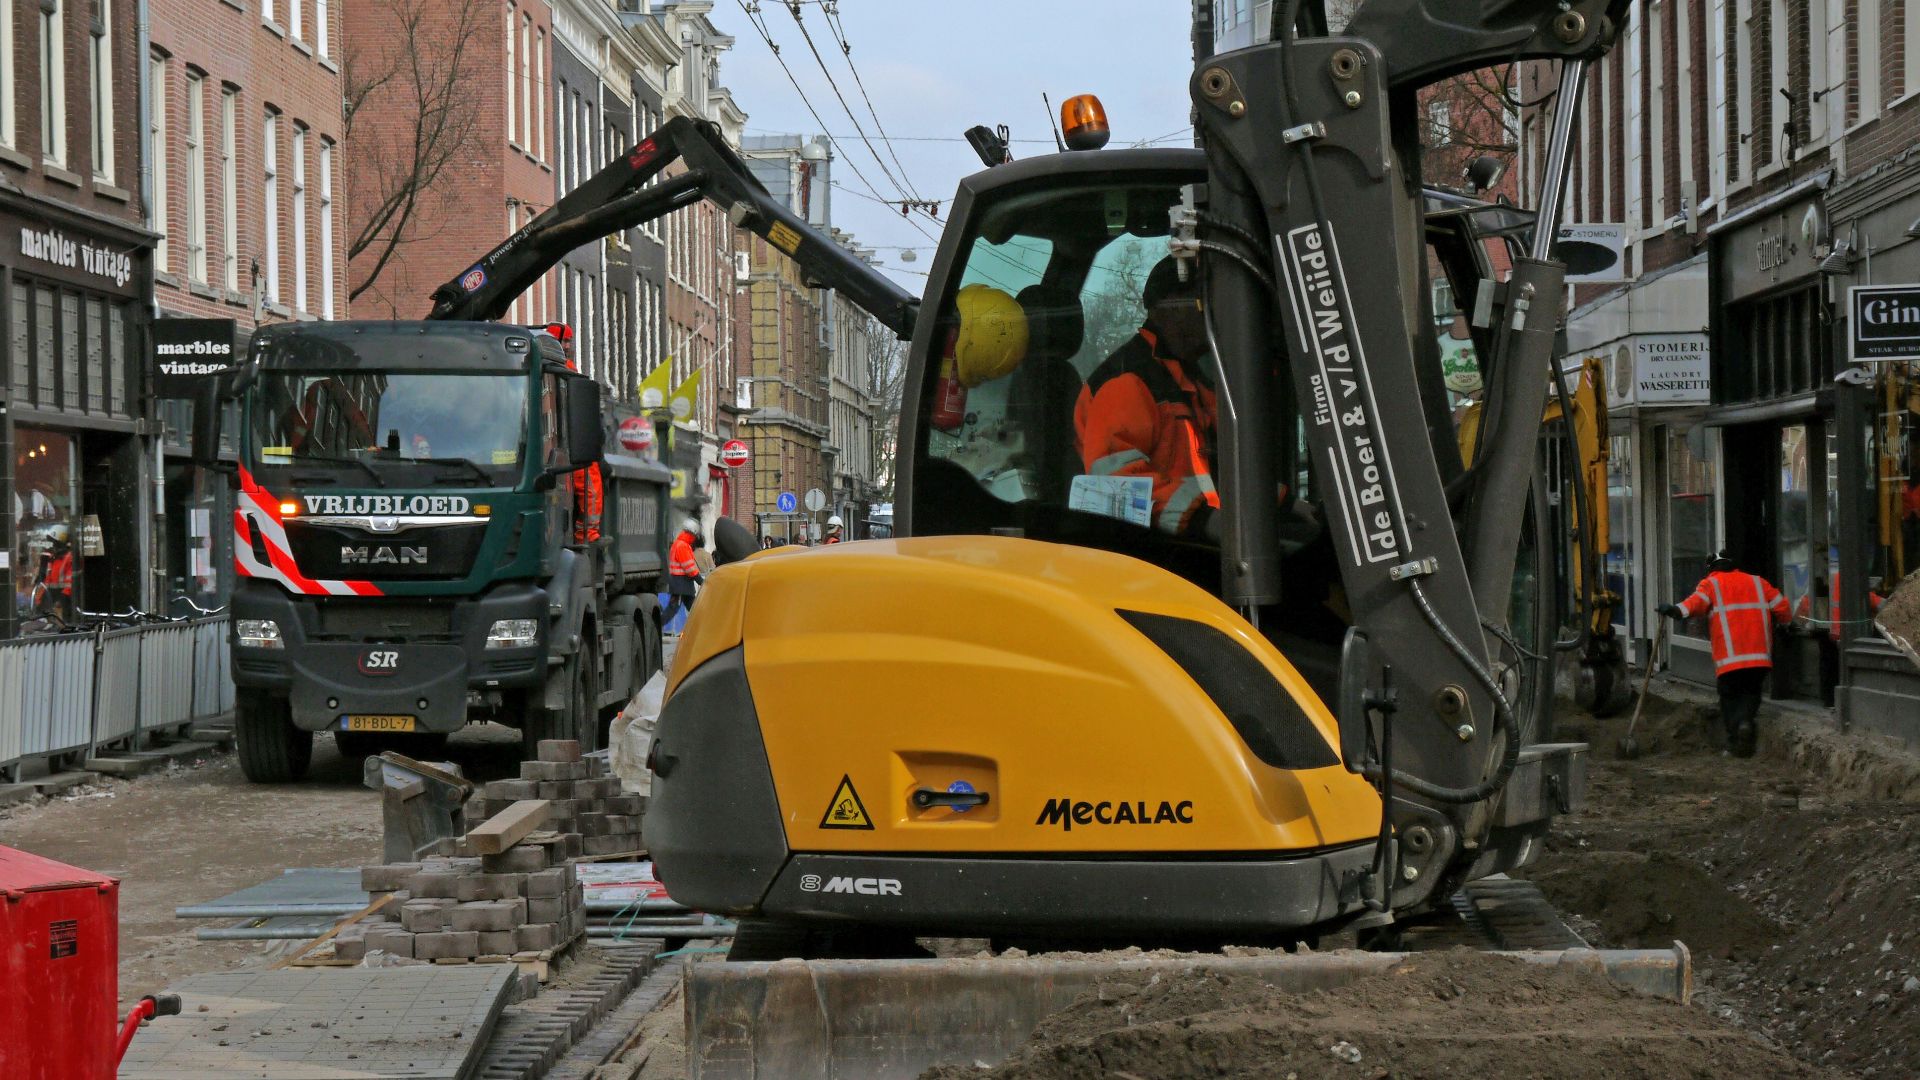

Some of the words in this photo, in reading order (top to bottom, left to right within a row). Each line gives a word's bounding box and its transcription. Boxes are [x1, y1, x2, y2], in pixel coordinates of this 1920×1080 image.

[21, 228, 76, 268] marbles
[81, 238, 131, 287] vintage
[489, 241, 513, 265] power
[464, 271, 481, 289] HMF
[157, 341, 230, 355] marbles
[1666, 354, 1701, 362] CLEANING
[1651, 371, 1702, 379] LAUNDRY
[1310, 374, 1332, 426] Firma
[1342, 404, 1366, 426] &
[1354, 436, 1385, 506] Boer
[303, 495, 469, 515] VRIJBLOED
[1370, 511, 1397, 549] de
[341, 546, 428, 564] MAN
[366, 651, 399, 668] SR
[353, 718, 409, 729] 81-BDL-7
[800, 874, 821, 892] 8
[822, 876, 902, 895] MCR
